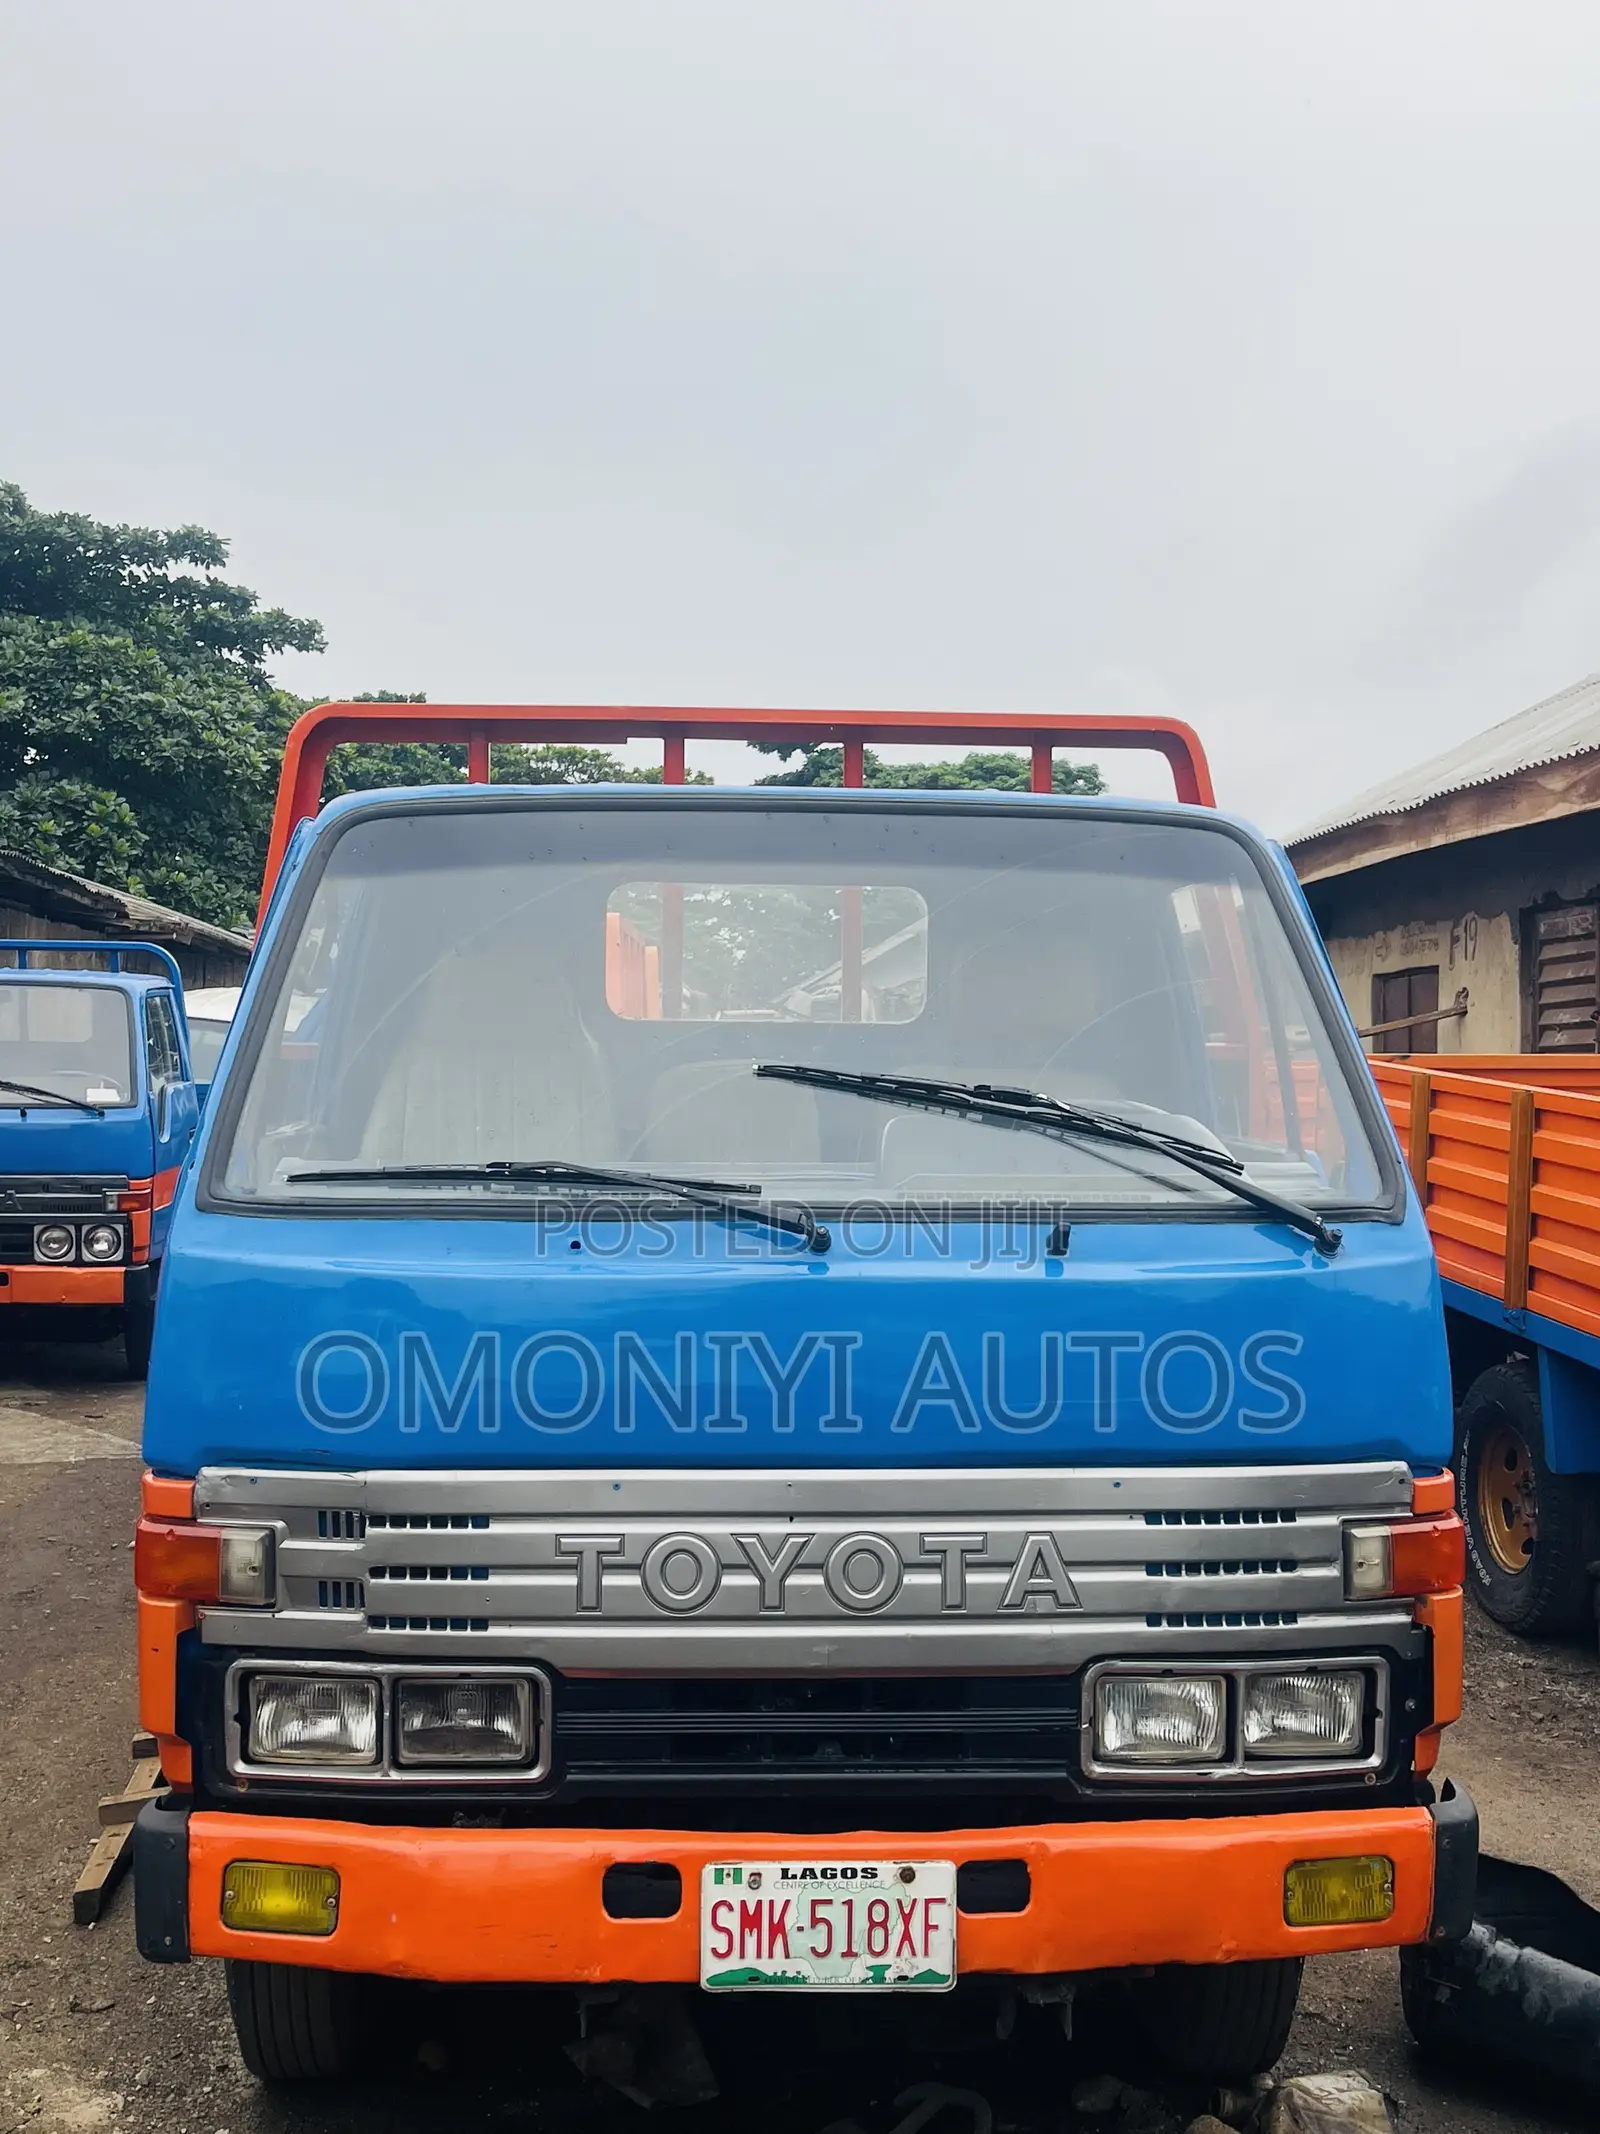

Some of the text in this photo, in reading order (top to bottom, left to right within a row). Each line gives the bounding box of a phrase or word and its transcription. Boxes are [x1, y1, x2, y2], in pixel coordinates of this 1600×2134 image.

[555, 1531, 1083, 1616] TOYOTA
[773, 1880, 885, 1890] CENTRE OF EXCELLENCE
[780, 1867, 879, 1880] LAGOS
[711, 1897, 947, 1960] SMK-518XF
